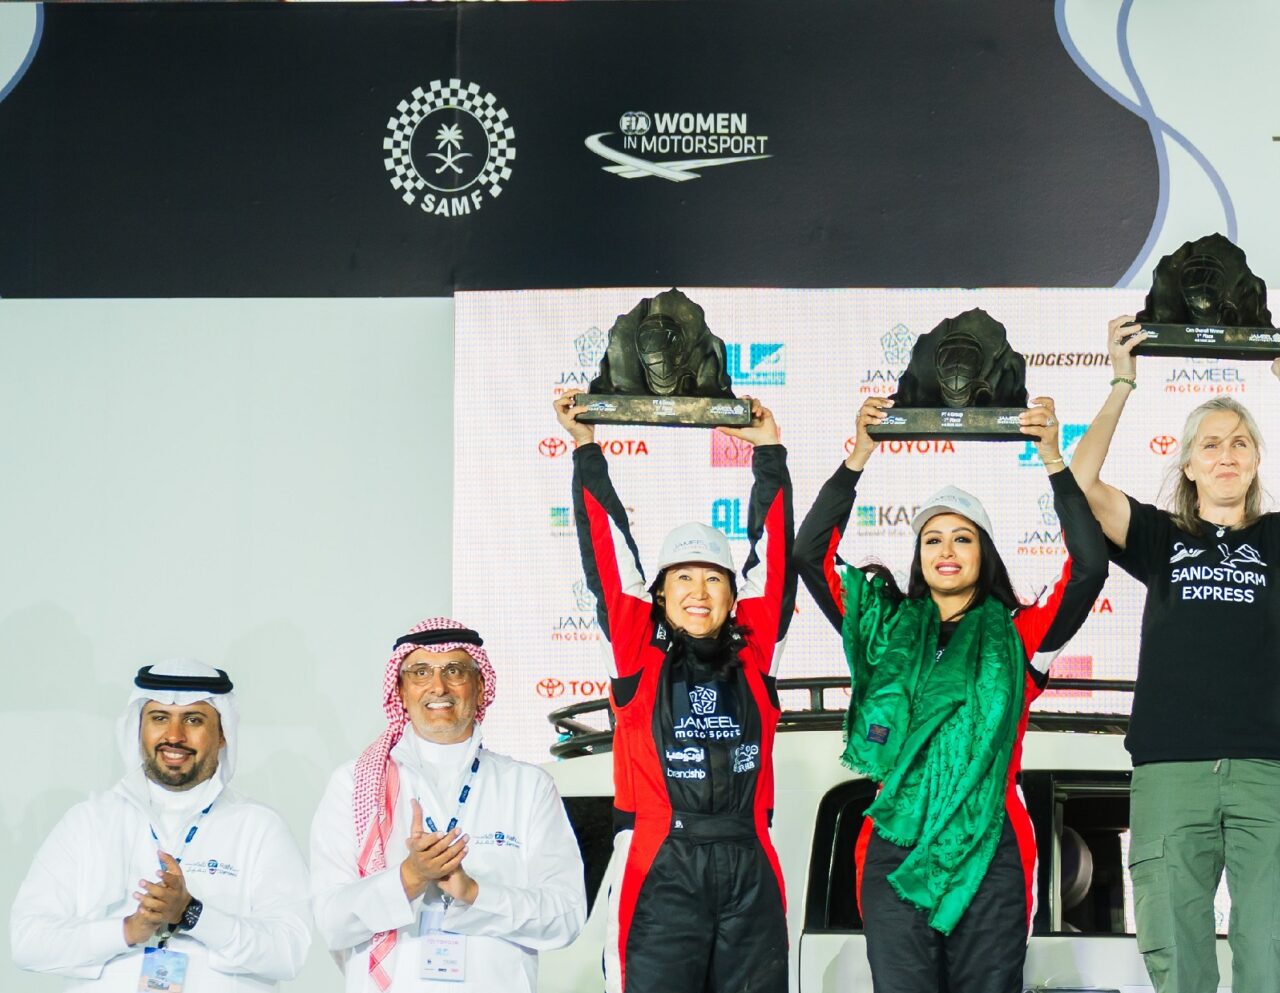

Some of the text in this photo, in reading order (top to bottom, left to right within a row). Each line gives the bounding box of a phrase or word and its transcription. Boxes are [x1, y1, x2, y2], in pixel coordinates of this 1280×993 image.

[620, 111, 748, 134] FIA WOMEN
[623, 136, 769, 154] IN MOTORSPORT
[420, 189, 484, 217] SAMF
[1166, 368, 1246, 382] JAMEEL
[1165, 384, 1246, 394] motorsport
[573, 440, 648, 457] YOTA
[1017, 531, 1063, 544] JAM
[1170, 567, 1267, 587] SANDSTORM
[1182, 585, 1255, 603] EXPRESS
[570, 681, 607, 696] TOY
[674, 716, 740, 730] JAMEEL
